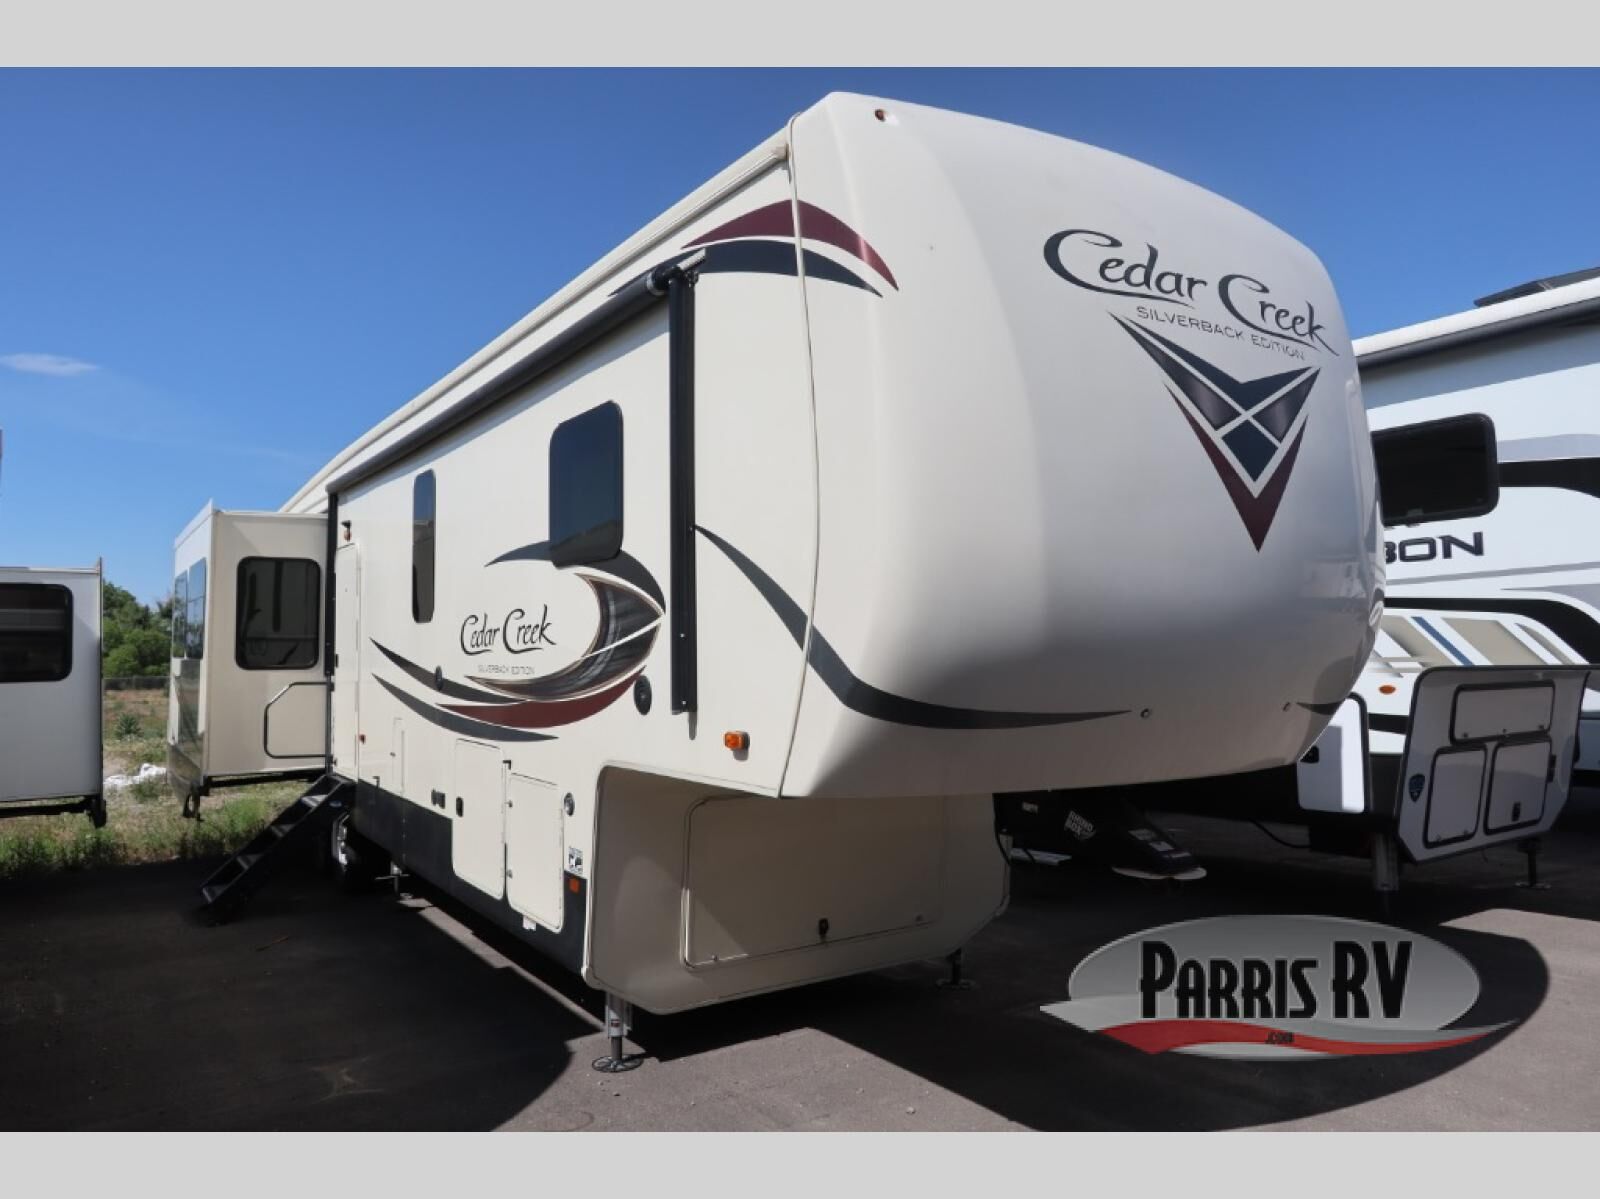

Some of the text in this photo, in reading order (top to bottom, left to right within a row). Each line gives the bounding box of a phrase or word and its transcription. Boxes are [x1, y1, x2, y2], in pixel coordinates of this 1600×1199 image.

[1043, 228, 1340, 357] Cedar Creek
[1136, 305, 1306, 360] SILVERBACK EDITION
[460, 603, 557, 656] Cedar Creek
